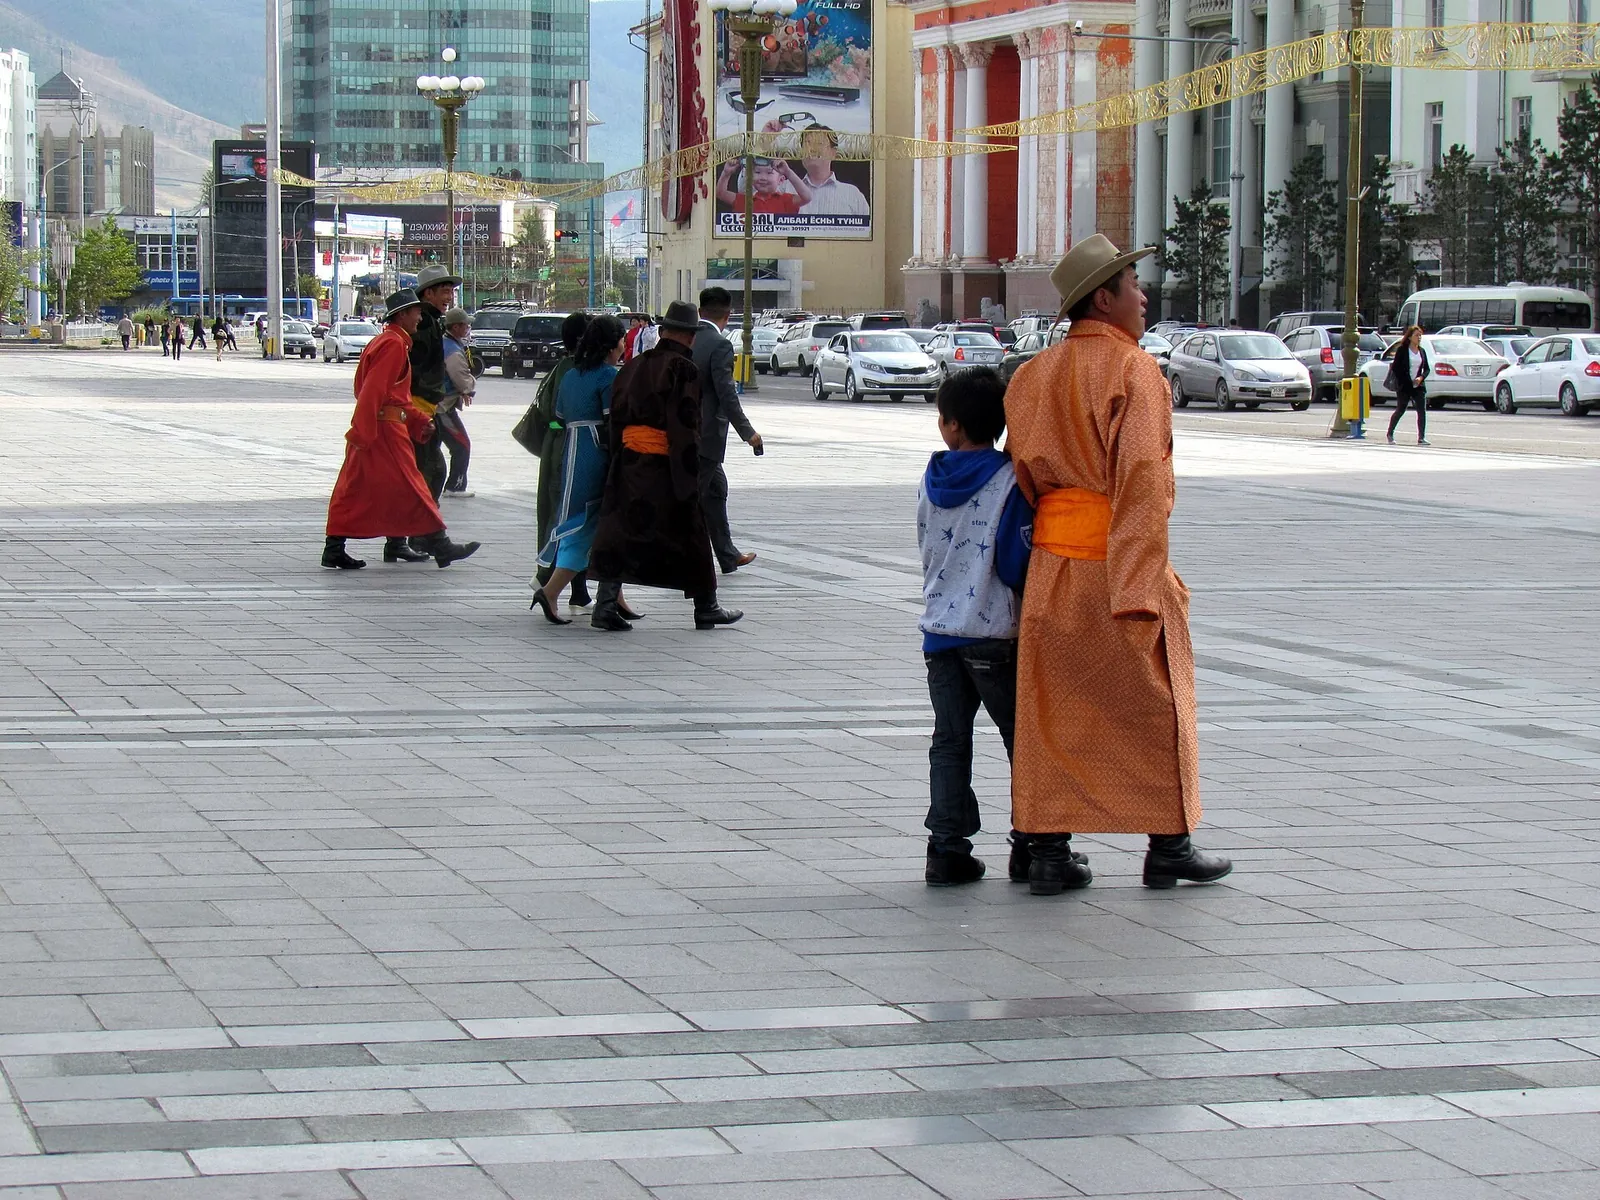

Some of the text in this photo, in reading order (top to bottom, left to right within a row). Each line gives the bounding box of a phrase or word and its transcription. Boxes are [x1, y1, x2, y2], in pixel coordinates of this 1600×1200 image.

[777, 217, 808, 225] АЛБАН
[810, 216, 835, 225] ЁСНЫ
[954, 538, 971, 550] stars
[977, 611, 991, 624] stars
